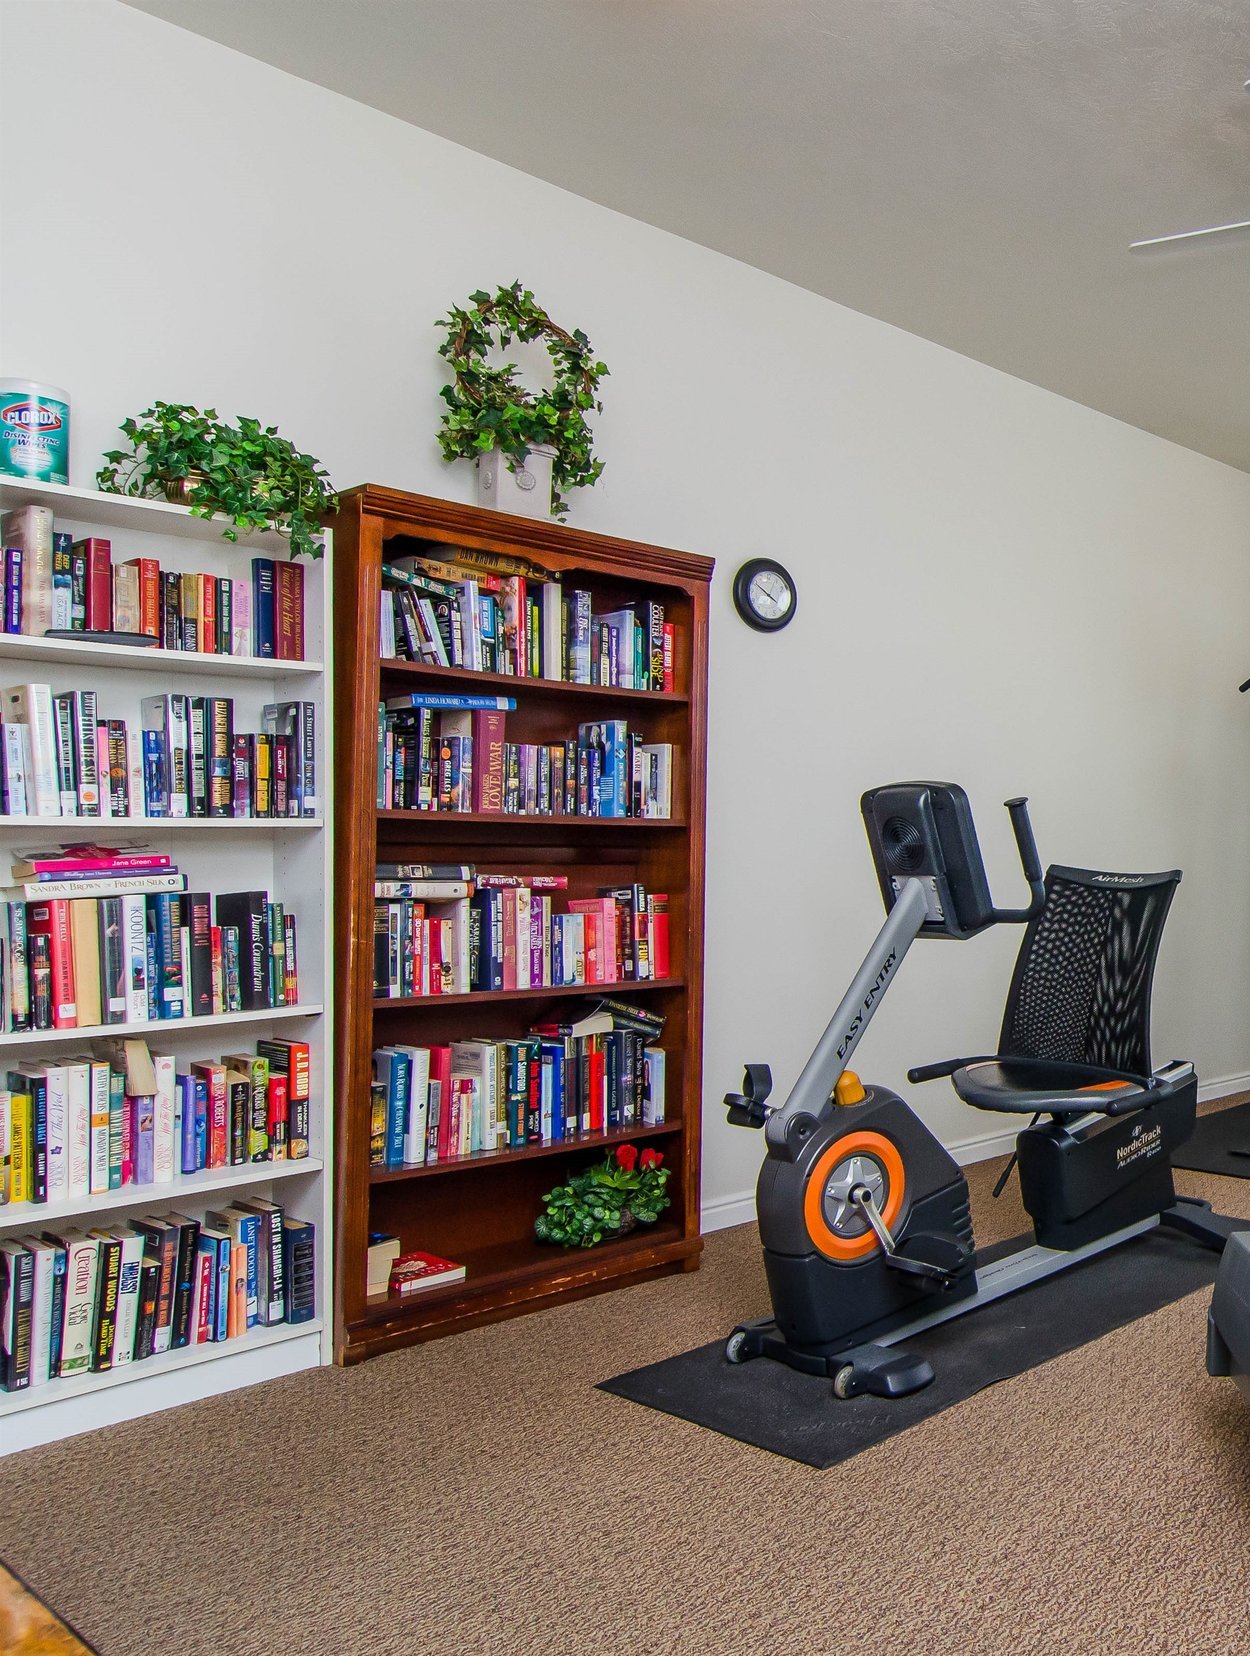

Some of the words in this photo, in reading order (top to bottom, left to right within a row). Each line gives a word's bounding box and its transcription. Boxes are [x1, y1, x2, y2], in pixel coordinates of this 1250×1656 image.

[7, 411, 57, 424] CLOROX
[3, 432, 60, 445] DISINCTING
[62, 554, 70, 569] DEEP
[283, 568, 293, 587] Voice
[56, 595, 64, 609] LISA
[283, 598, 292, 610] the
[282, 612, 293, 636] Heart
[84, 694, 95, 714] DAVID
[80, 716, 94, 739] ELLIS
[215, 701, 226, 732] ELIZABETH
[80, 743, 95, 762] LIFE
[109, 740, 117, 765] BERRY
[118, 740, 126, 765] STEVE
[175, 749, 184, 763] KILL
[215, 734, 226, 757] GEORGE
[490, 742, 502, 770] WAR
[175, 765, 184, 779] ALEX
[235, 757, 244, 781] LOWELL
[304, 761, 314, 777] JOHN
[176, 781, 185, 793] CRO
[212, 784, 221, 808] MEMORY
[489, 775, 501, 809] LOVE
[131, 857, 152, 866] Green
[30, 884, 66, 894] SANDRA
[70, 881, 101, 891] BROWN
[114, 880, 145, 889] FRENCH
[146, 878, 166, 887] SILK
[1092, 875, 1144, 883] AirMesh
[170, 902, 181, 926] BARBARA
[130, 909, 144, 953] KOONTZ
[251, 914, 263, 942] Dunn's
[16, 937, 24, 951] SICK
[171, 928, 181, 962] KINGSOLVER
[253, 942, 263, 992] Conundrum
[836, 1008, 864, 1060] EASY
[864, 947, 897, 1009] ENTRY
[296, 1052, 306, 1061] J.
[518, 1047, 527, 1061] JOHN
[97, 1069, 107, 1086] KATHY
[296, 1062, 307, 1071] D.
[396, 1064, 406, 1077] NORA
[517, 1062, 526, 1091] SANDFORD
[530, 1062, 540, 1077] John
[215, 1082, 225, 1100] NORA
[296, 1072, 308, 1096] ROBB
[529, 1079, 540, 1109] Sandford
[38, 1087, 46, 1122] UNDERCOVER
[50, 1091, 64, 1112] Wed
[97, 1087, 108, 1112] REICHS
[251, 1086, 266, 1109] ROBERTS
[51, 1115, 63, 1133] Thee
[215, 1099, 224, 1127] ROBERTS
[13, 1123, 23, 1140] JAMES
[37, 1123, 47, 1144] TARGET
[96, 1129, 107, 1154] MONDAY
[1117, 1125, 1161, 1159] NordicTrack
[14, 1141, 24, 1170] PATTERSON
[247, 1221, 255, 1246] JANET
[272, 1213, 281, 1232] LOST
[272, 1235, 282, 1243] IN
[21, 1256, 33, 1278] SCOTT
[74, 1247, 97, 1295] Creation
[108, 1247, 120, 1277] STUART
[184, 1247, 193, 1282] Earthquakes
[247, 1248, 255, 1279] WOODS
[120, 1261, 139, 1294] EMBASSY
[106, 1280, 118, 1312] WOODS
[181, 1291, 190, 1313] Jennifer
[68, 1303, 81, 1326] Vidal
[81, 1302, 92, 1325] Gore
[101, 1319, 110, 1339] HARD
